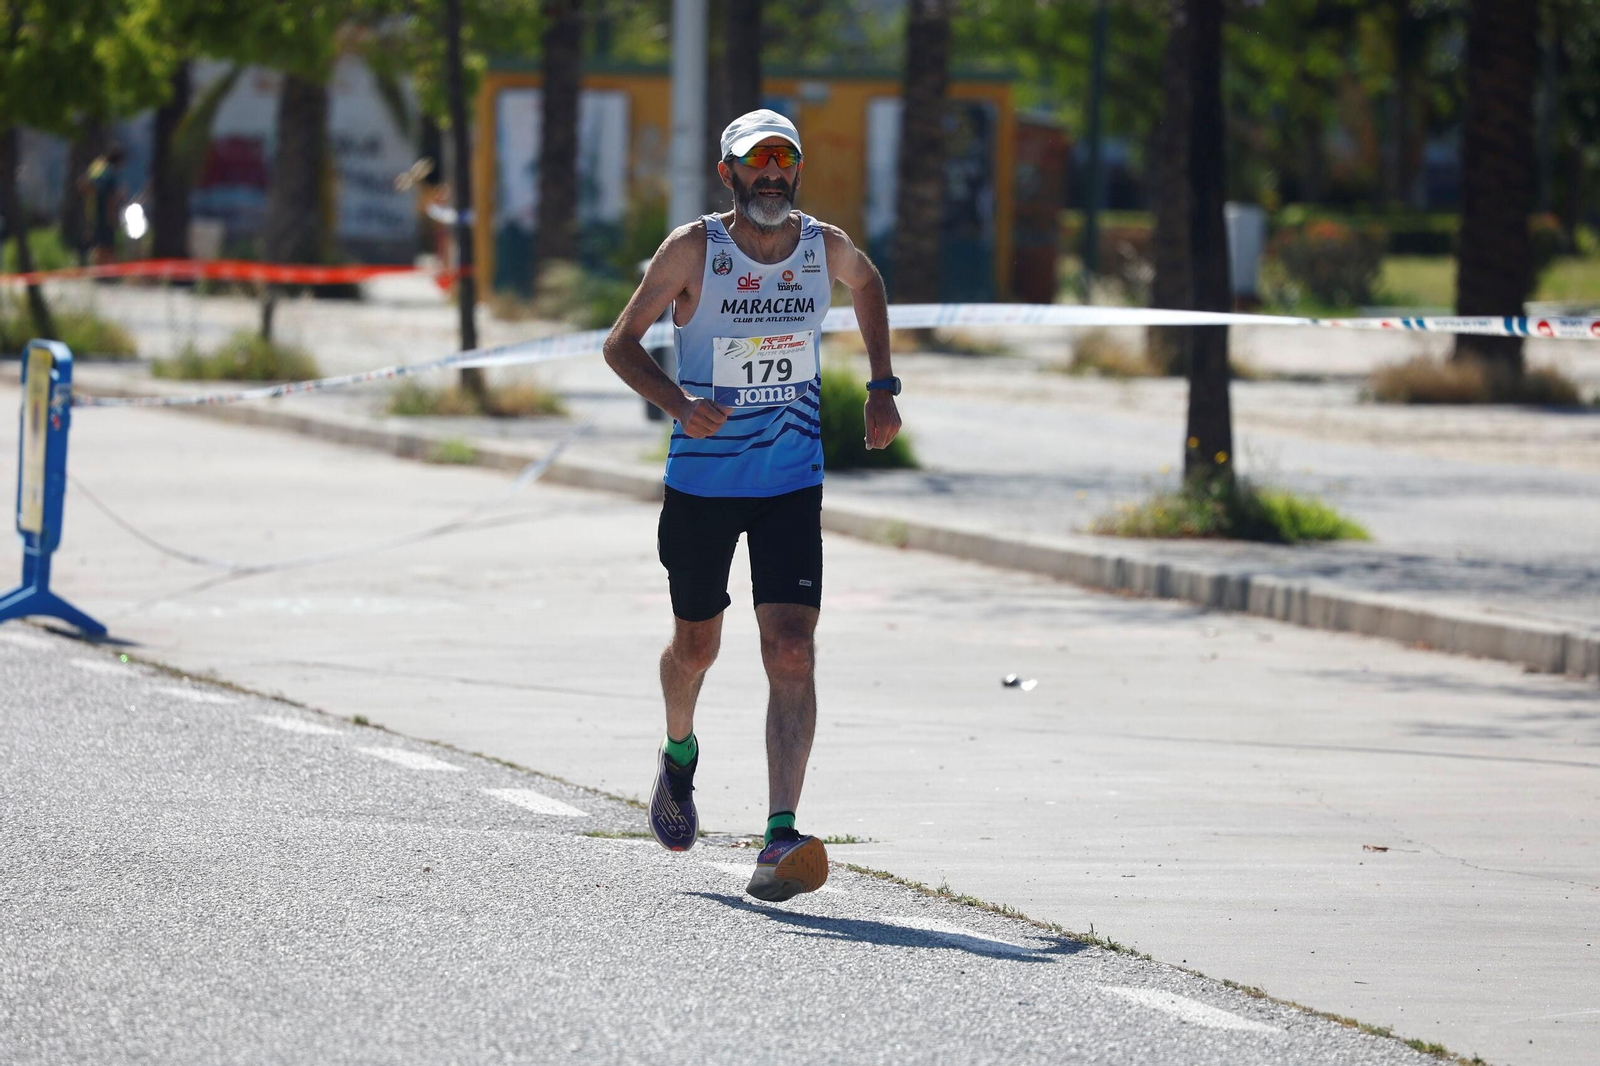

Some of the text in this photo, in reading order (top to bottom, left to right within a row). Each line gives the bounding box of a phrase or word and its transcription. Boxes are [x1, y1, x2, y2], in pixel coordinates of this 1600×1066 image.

[778, 282, 802, 292] mayfo
[720, 298, 815, 314] MARACENA
[759, 340, 805, 351] ATLETISMO
[778, 347, 806, 356] RUNNING
[741, 358, 793, 384] 179
